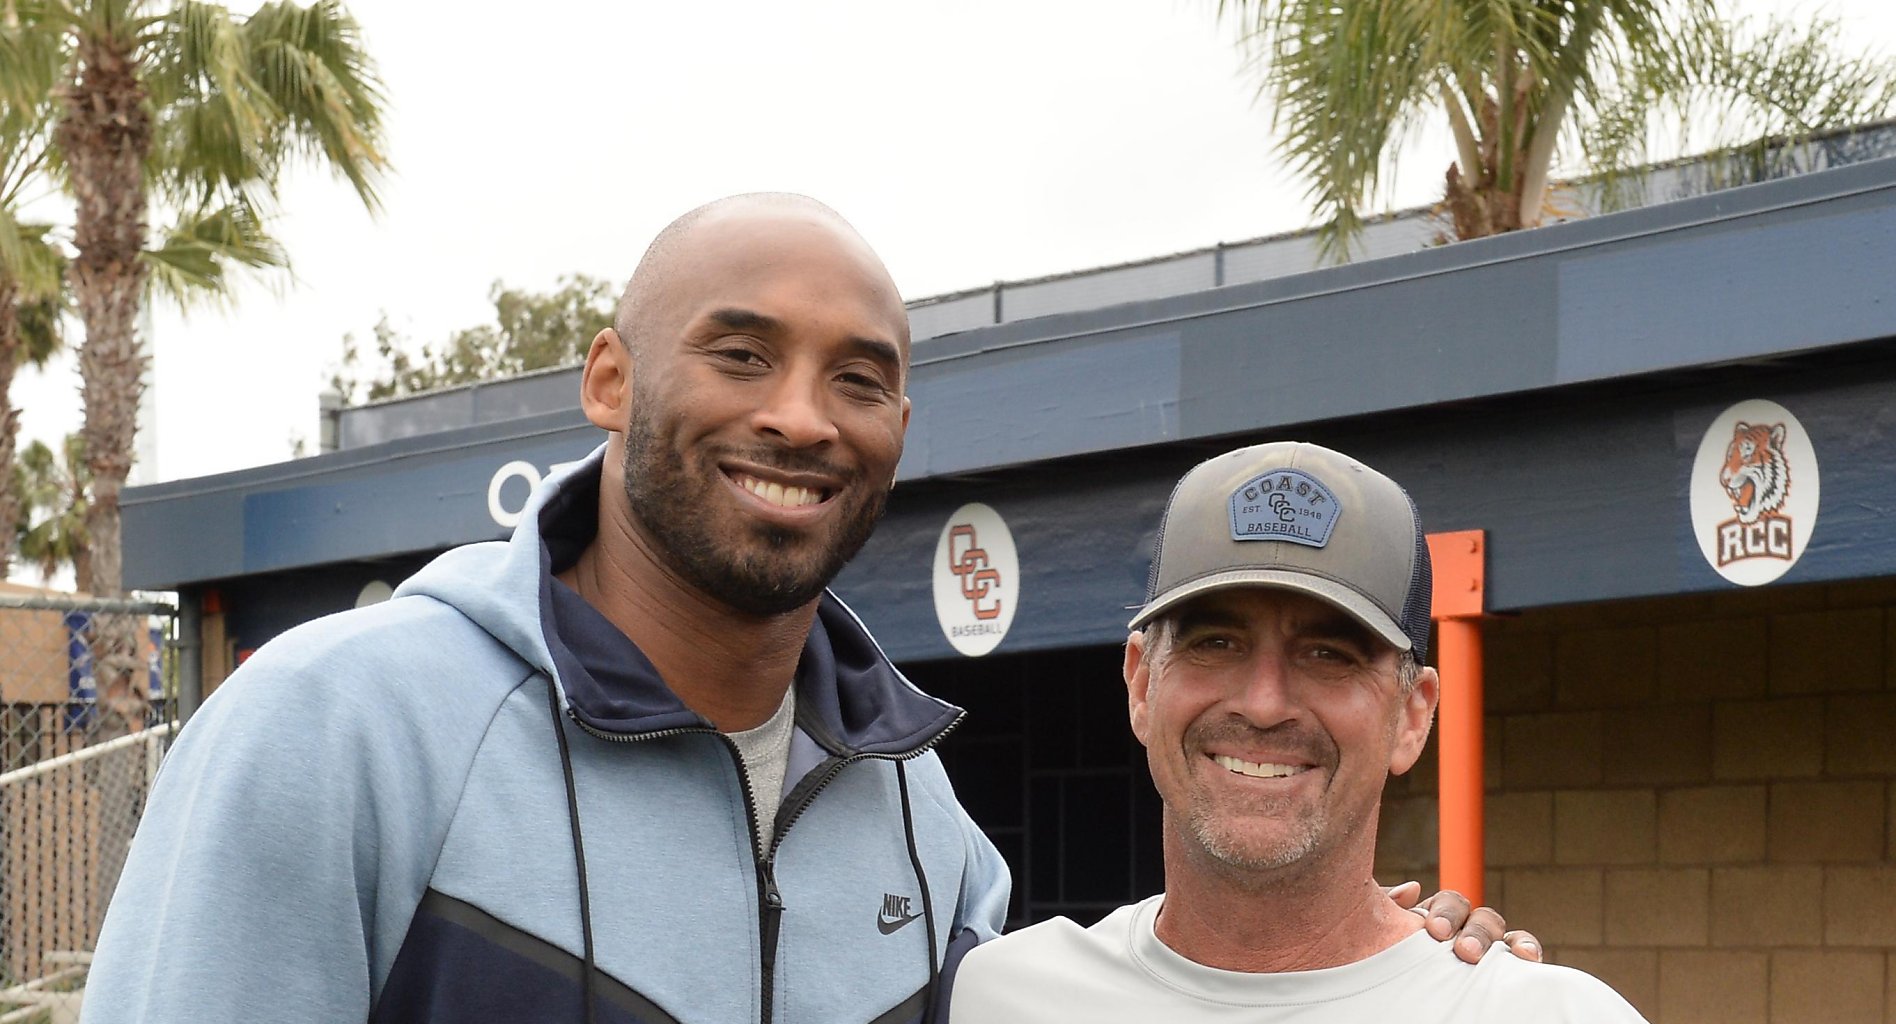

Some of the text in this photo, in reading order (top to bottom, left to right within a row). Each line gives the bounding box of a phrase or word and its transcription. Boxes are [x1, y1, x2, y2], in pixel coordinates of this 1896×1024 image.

[1244, 475, 1326, 506] COAST
[1242, 505, 1322, 520] EST. 1948
[1247, 522, 1312, 537] BASEBALL
[1717, 516, 1793, 567] RCC
[952, 624, 1003, 638] BASEBALL
[882, 892, 911, 919] NIKE
